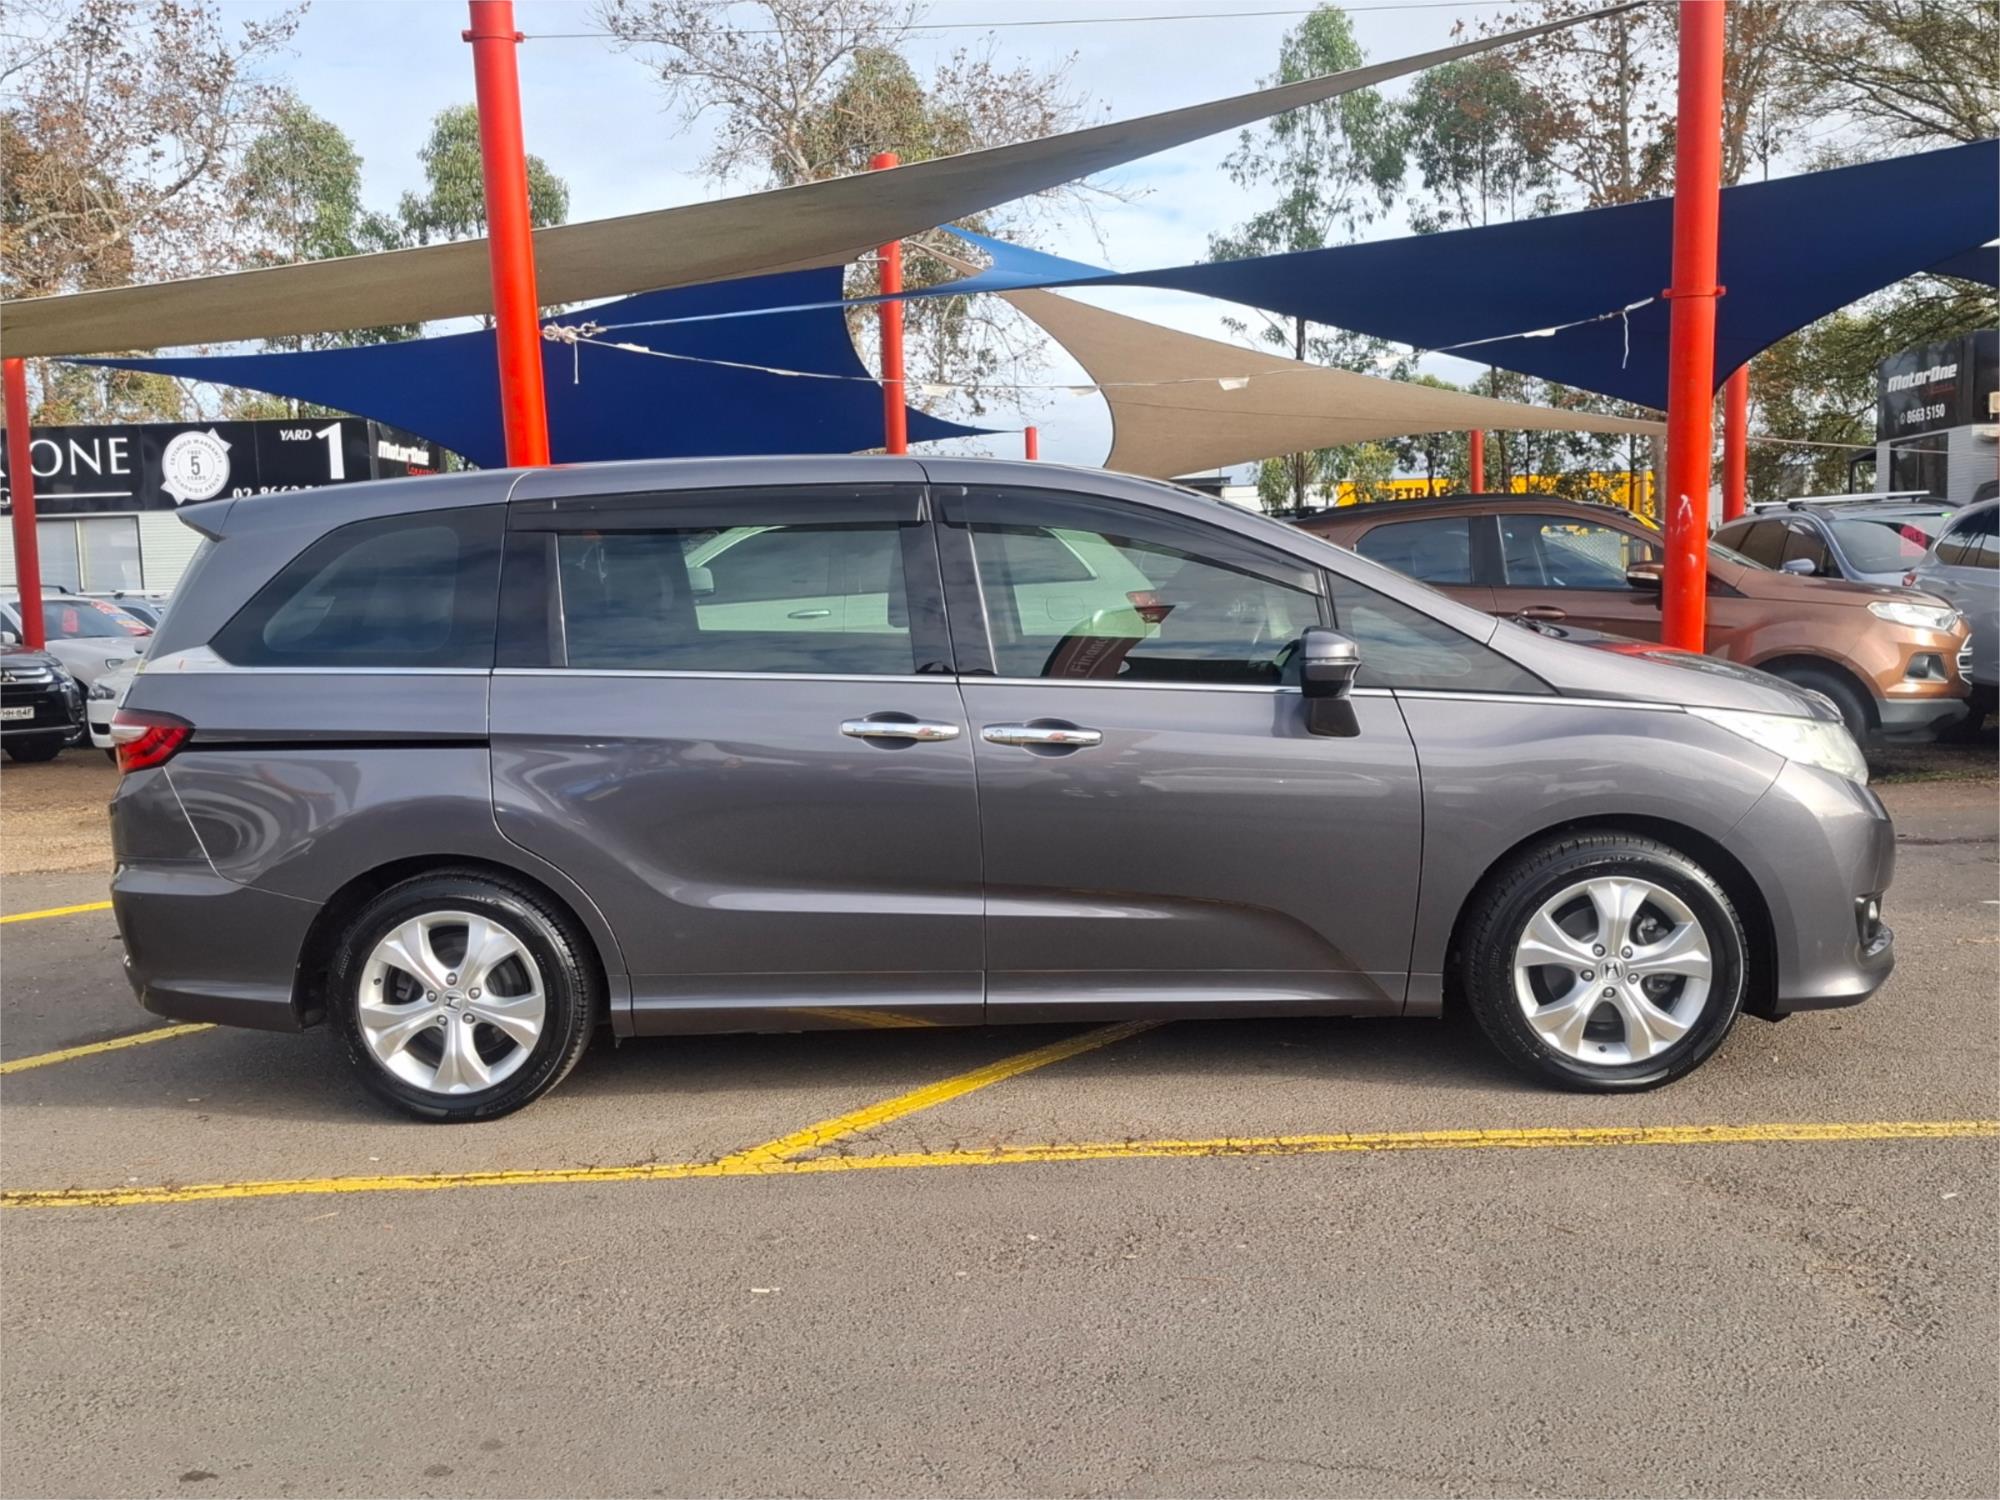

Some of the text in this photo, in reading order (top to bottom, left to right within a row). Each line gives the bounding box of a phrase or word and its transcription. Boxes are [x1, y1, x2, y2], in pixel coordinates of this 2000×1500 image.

[1887, 363, 1957, 393] MotorOne
[1906, 403, 1945, 424] 8663 5150
[29, 437, 131, 476] ONE
[191, 455, 201, 476] 5
[279, 422, 345, 480] YARD 1
